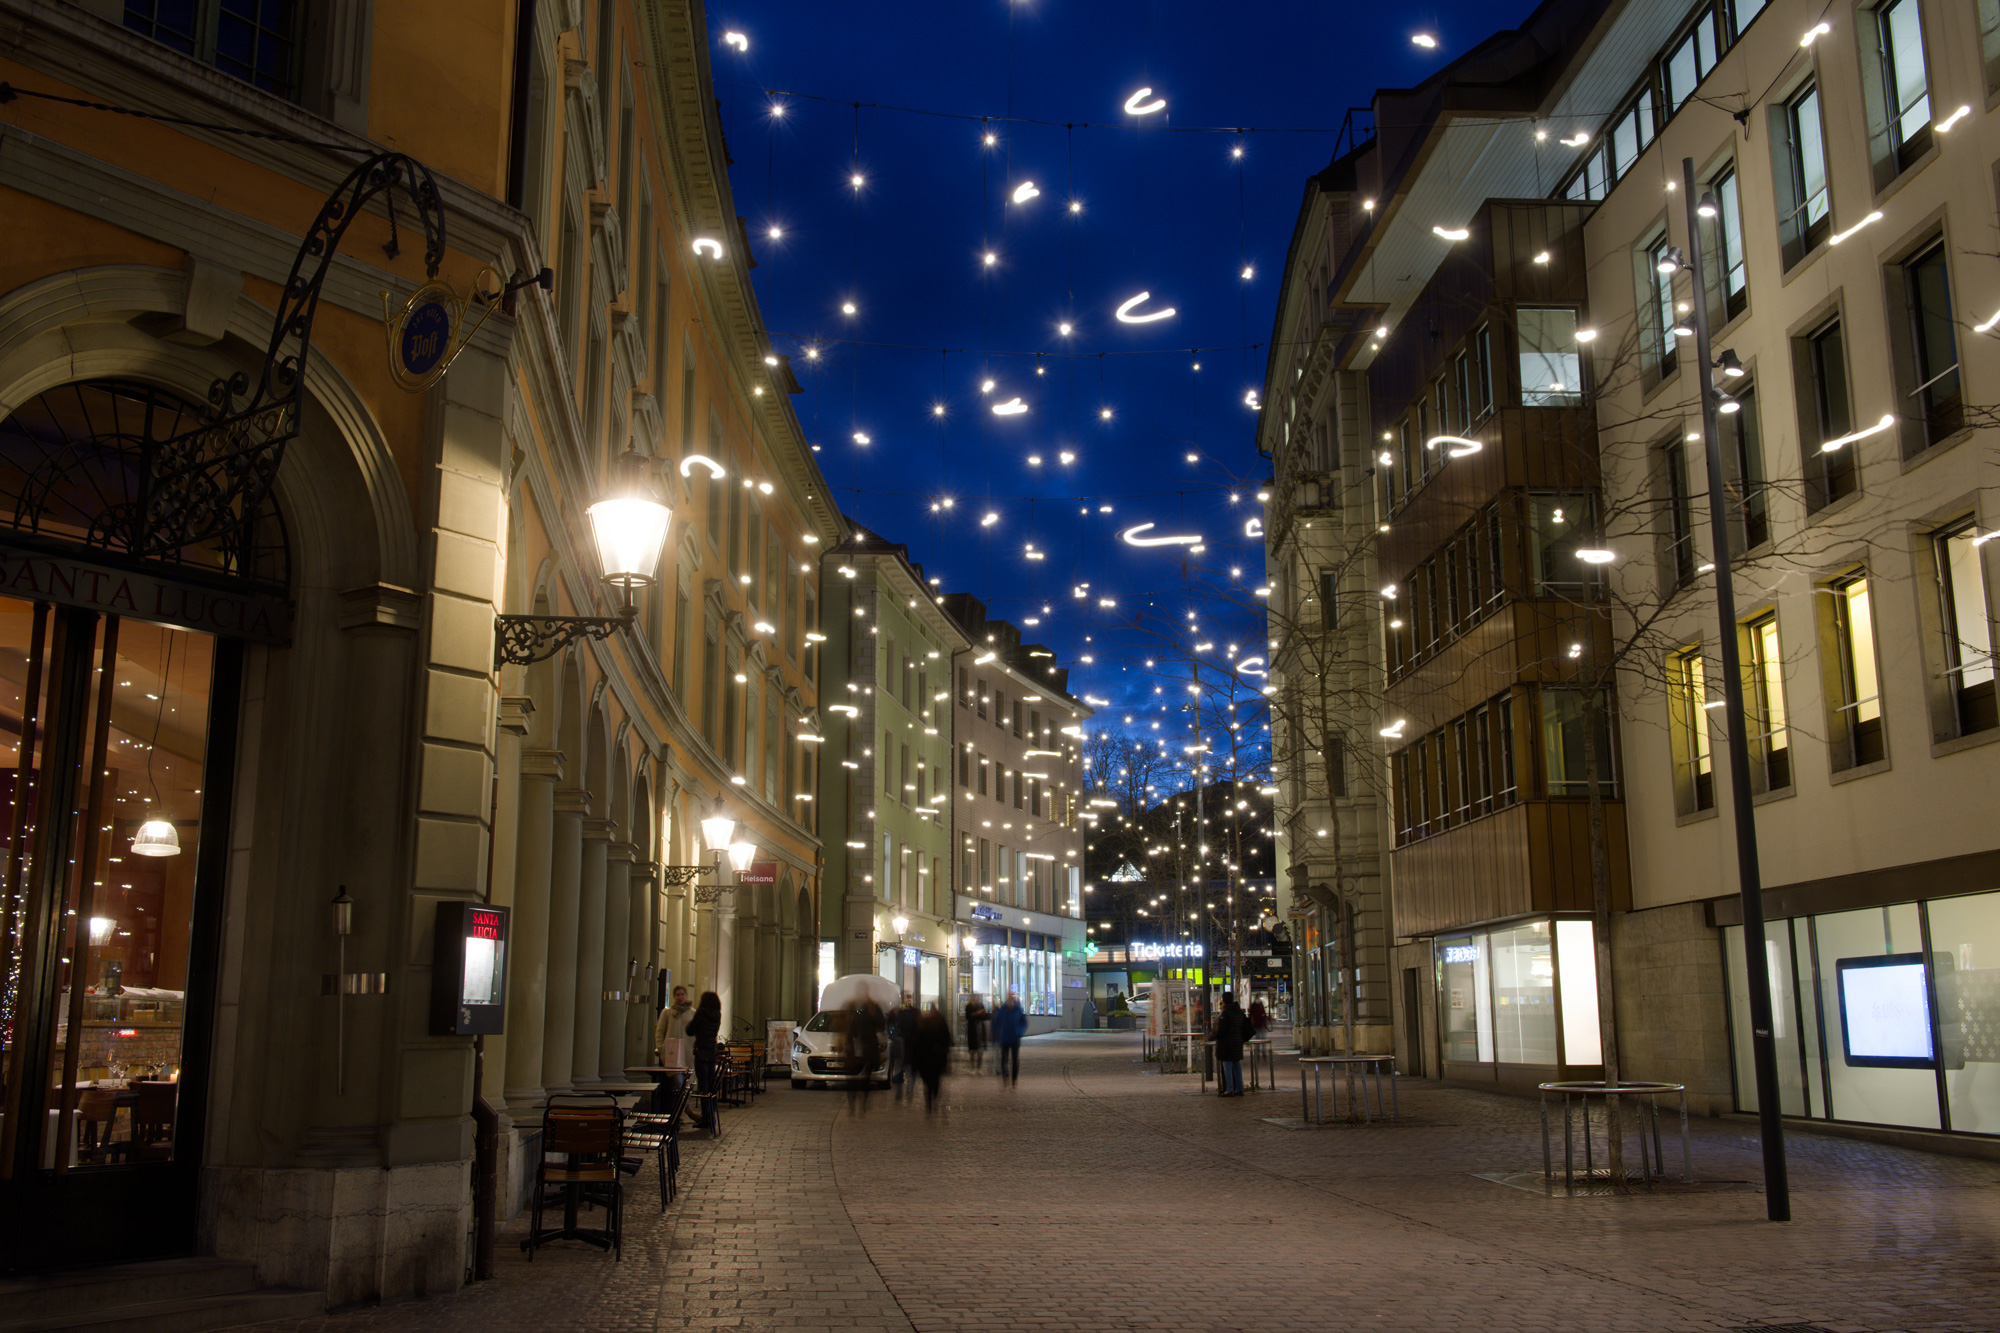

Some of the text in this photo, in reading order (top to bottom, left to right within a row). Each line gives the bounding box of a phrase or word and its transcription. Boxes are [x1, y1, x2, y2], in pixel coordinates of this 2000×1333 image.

[152, 583, 275, 637] LUCIA
[473, 912, 499, 926] SANTA
[473, 926, 498, 939] LUCIA
[1131, 941, 1203, 957] Ticketeria
[1882, 1003, 1902, 1018] UBS
